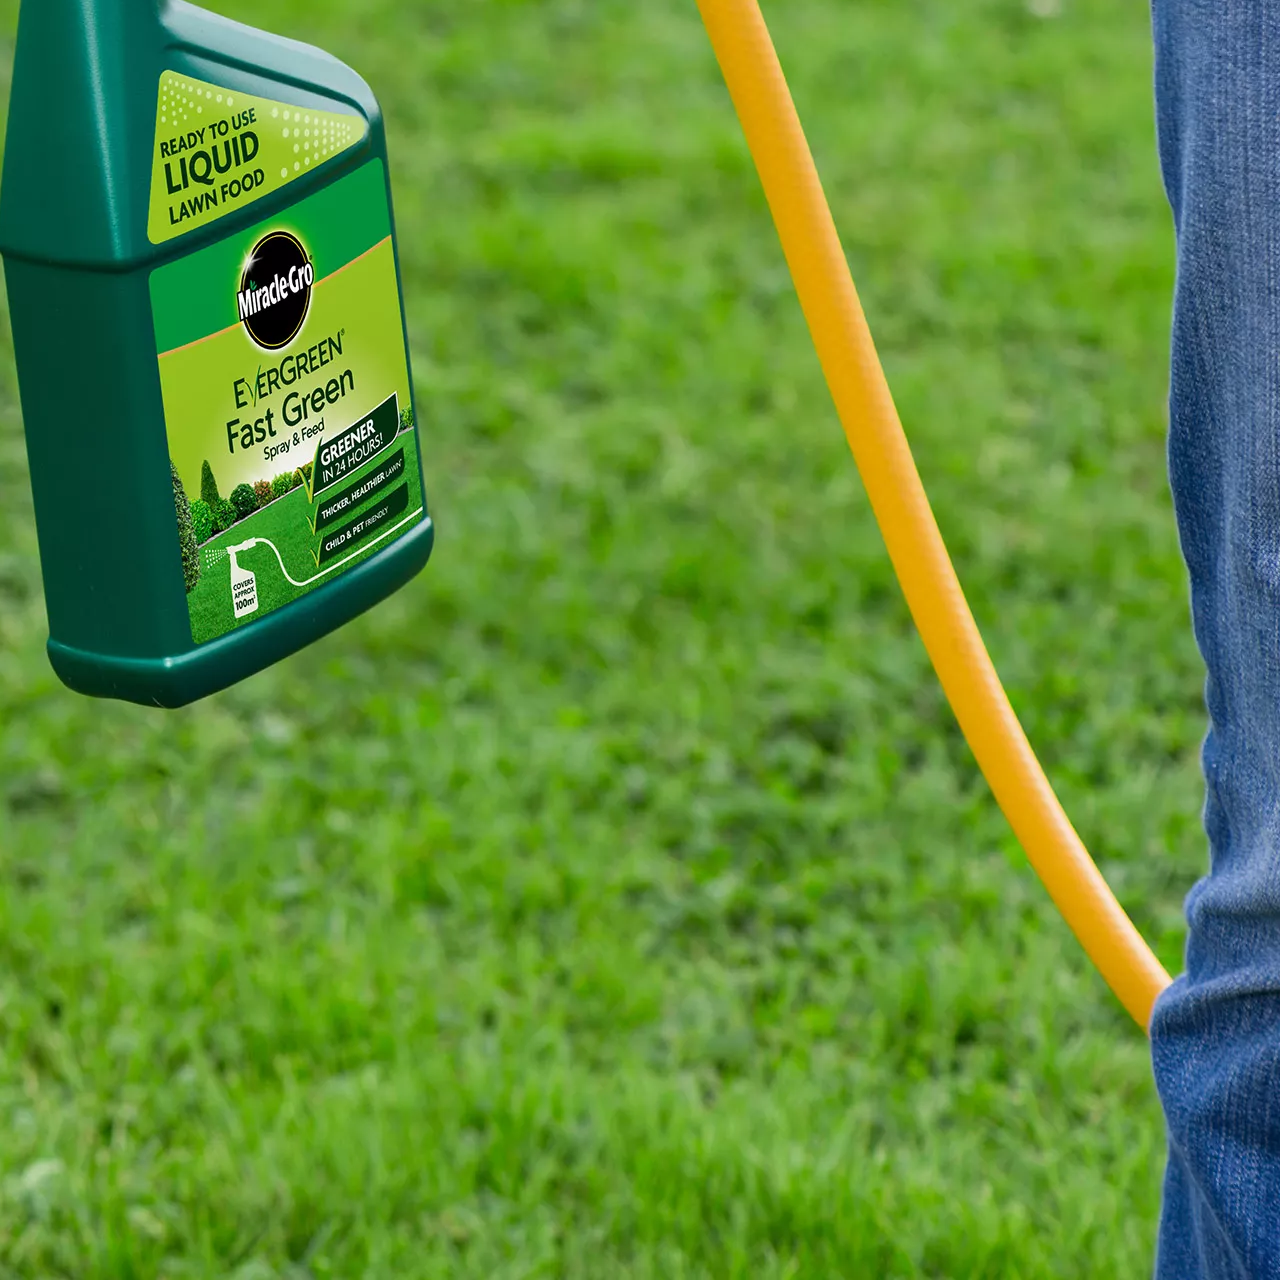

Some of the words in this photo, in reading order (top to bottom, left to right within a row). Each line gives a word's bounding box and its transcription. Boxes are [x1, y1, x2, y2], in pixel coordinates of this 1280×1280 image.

[160, 128, 206, 158] READY
[208, 120, 229, 139] TO
[231, 108, 257, 130] USE
[164, 131, 260, 195] LIQUID
[169, 189, 218, 225] LAWN
[221, 168, 265, 203] FOOD
[226, 407, 277, 454] Fast
[282, 369, 355, 427] Green
[263, 442, 291, 461] Spray
[292, 433, 301, 446] &
[301, 418, 325, 441] Feed
[320, 419, 376, 466] GREENER
[322, 467, 335, 483] IN
[335, 461, 347, 476] 24
[347, 432, 384, 468] HOURS!
[322, 496, 352, 519] THICKER,
[351, 472, 386, 500] HEALTHIER
[325, 531, 345, 552] CHILD
[346, 528, 352, 538] &
[352, 521, 365, 533] PET
[233, 578, 254, 591] COVERS
[234, 586, 255, 600] APPROX
